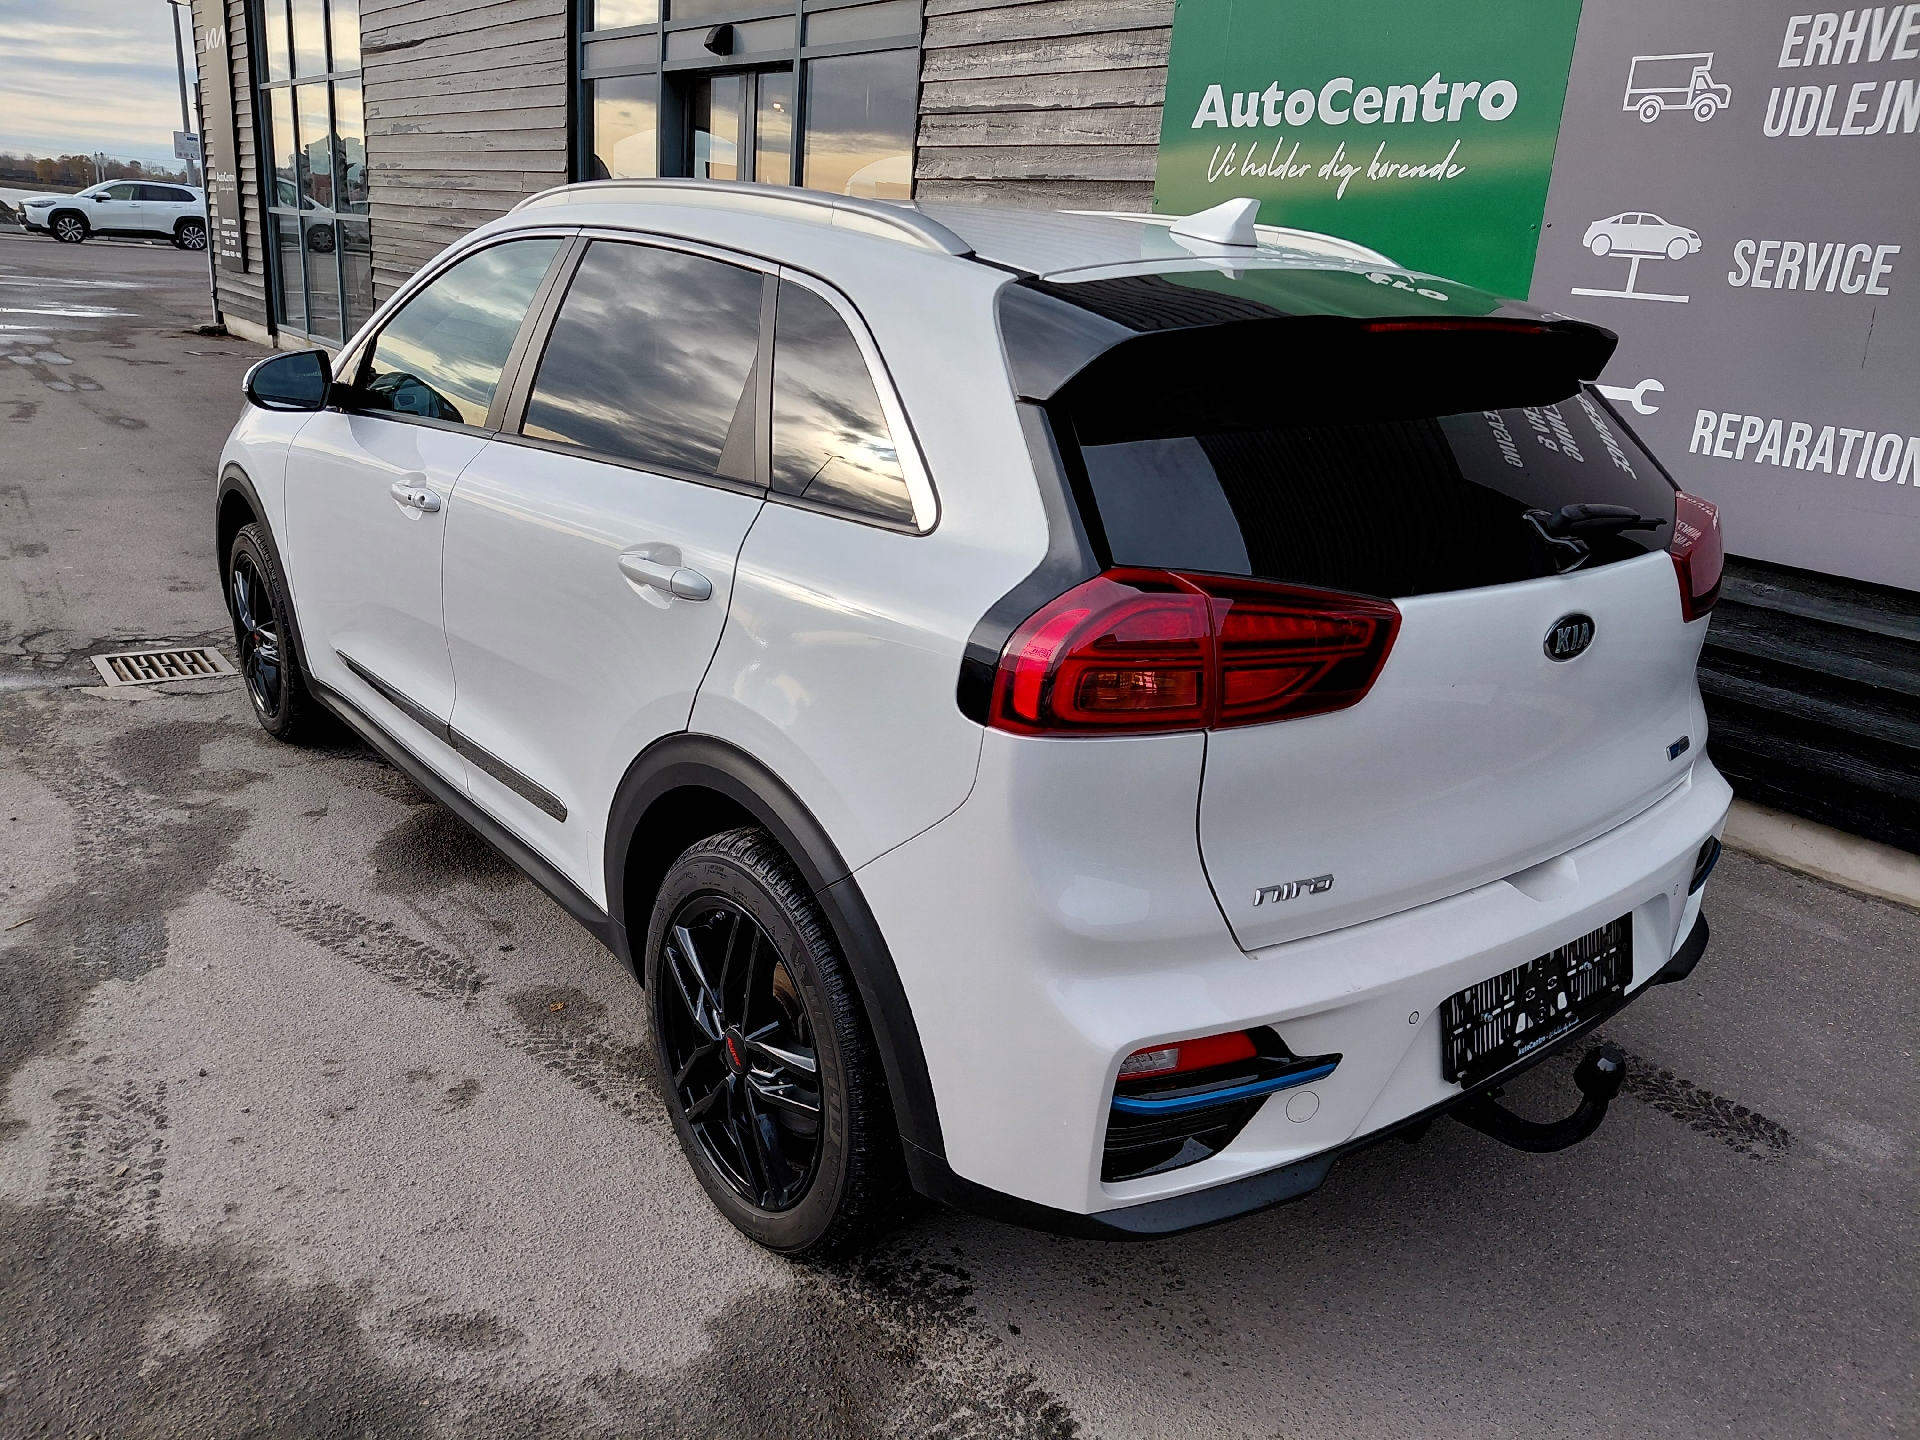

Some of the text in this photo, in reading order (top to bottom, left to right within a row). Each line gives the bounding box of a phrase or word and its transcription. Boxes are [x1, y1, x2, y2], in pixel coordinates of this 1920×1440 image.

[1191, 72, 1518, 129] AutoCentro
[1207, 136, 1467, 200] Vi holder dig kørende
[1727, 239, 1901, 296] SERVICE
[1556, 621, 1590, 654] KIA
[1253, 874, 1334, 907] niro
